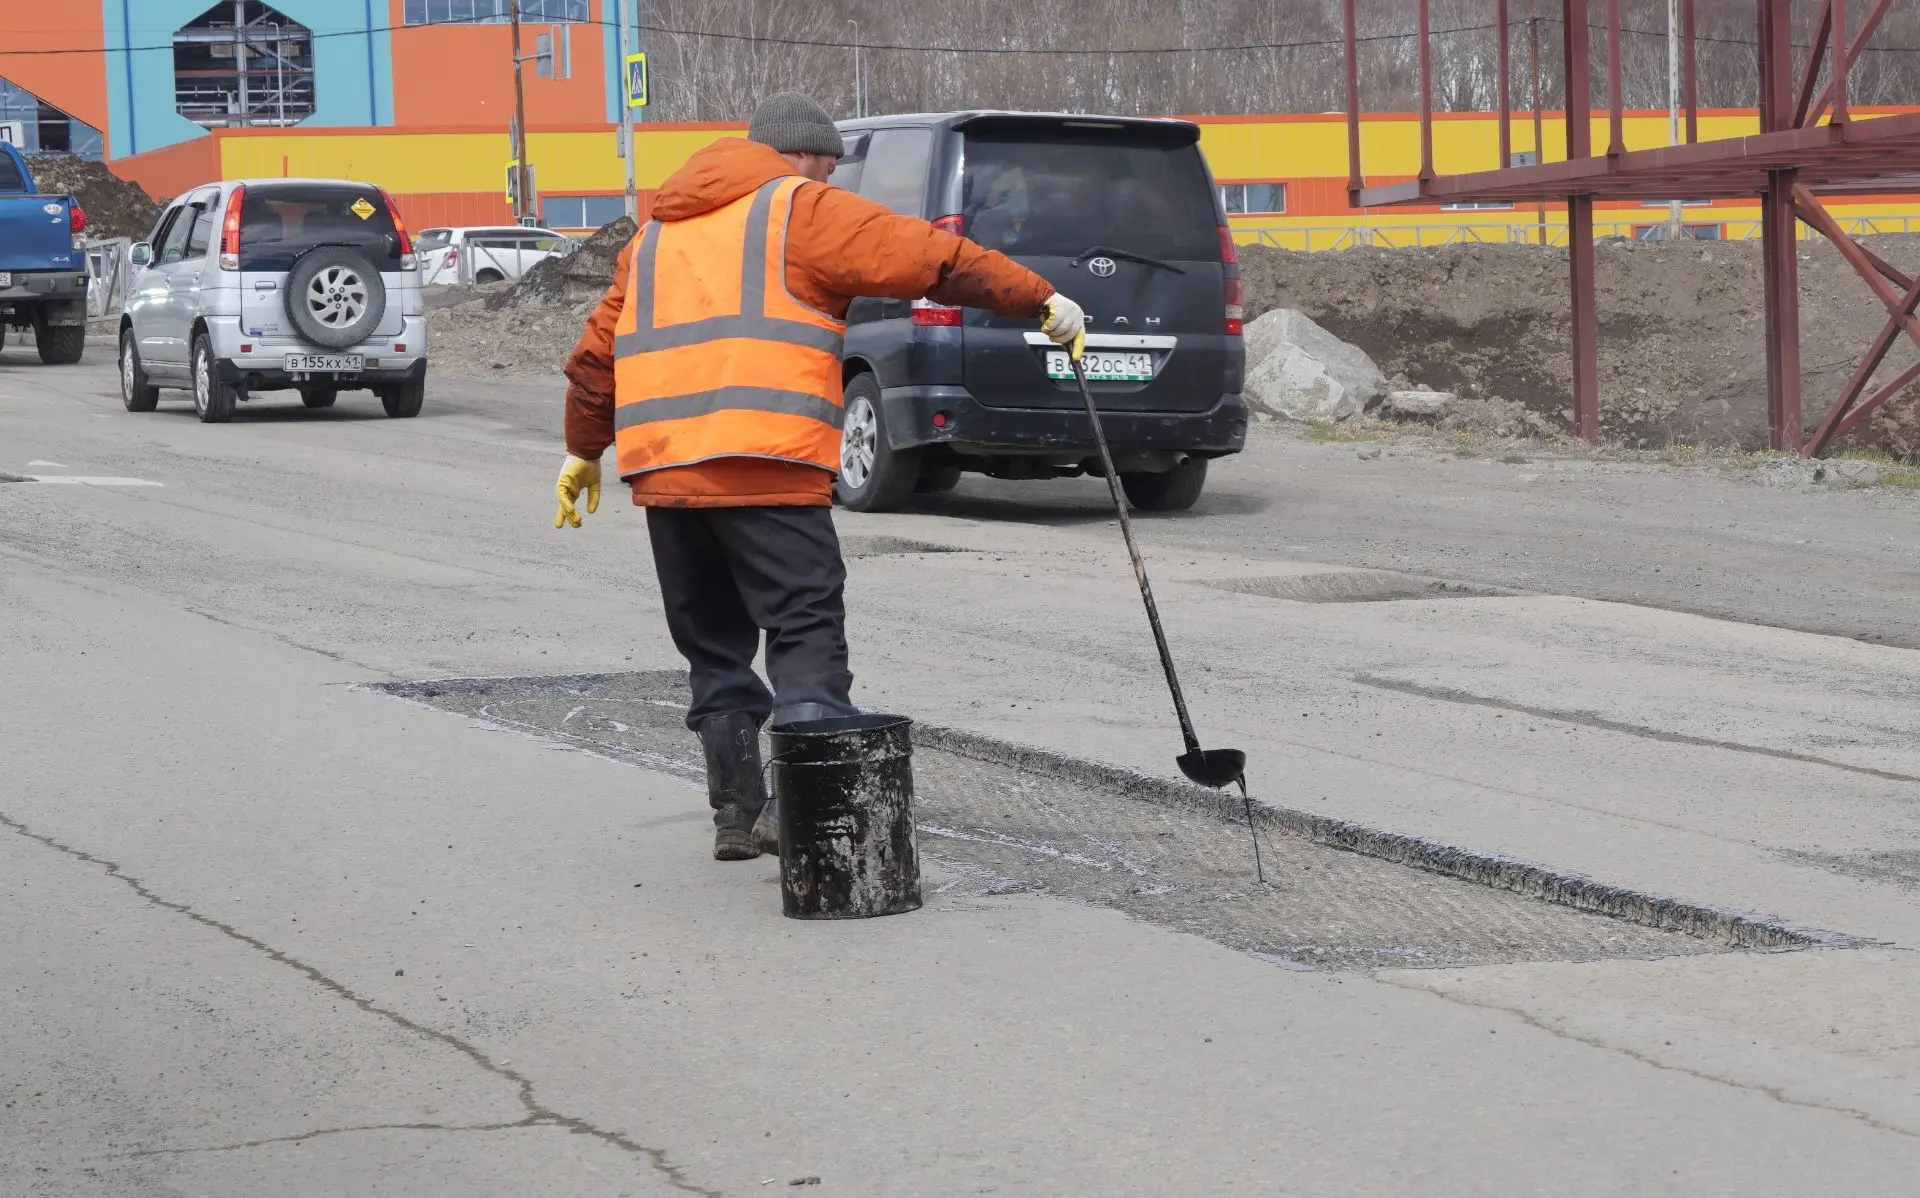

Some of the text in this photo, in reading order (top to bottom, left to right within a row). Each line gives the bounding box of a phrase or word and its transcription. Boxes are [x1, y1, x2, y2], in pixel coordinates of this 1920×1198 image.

[1083, 315, 1161, 325] OAH
[345, 356, 358, 366] 41
[1129, 355, 1145, 369] 41
